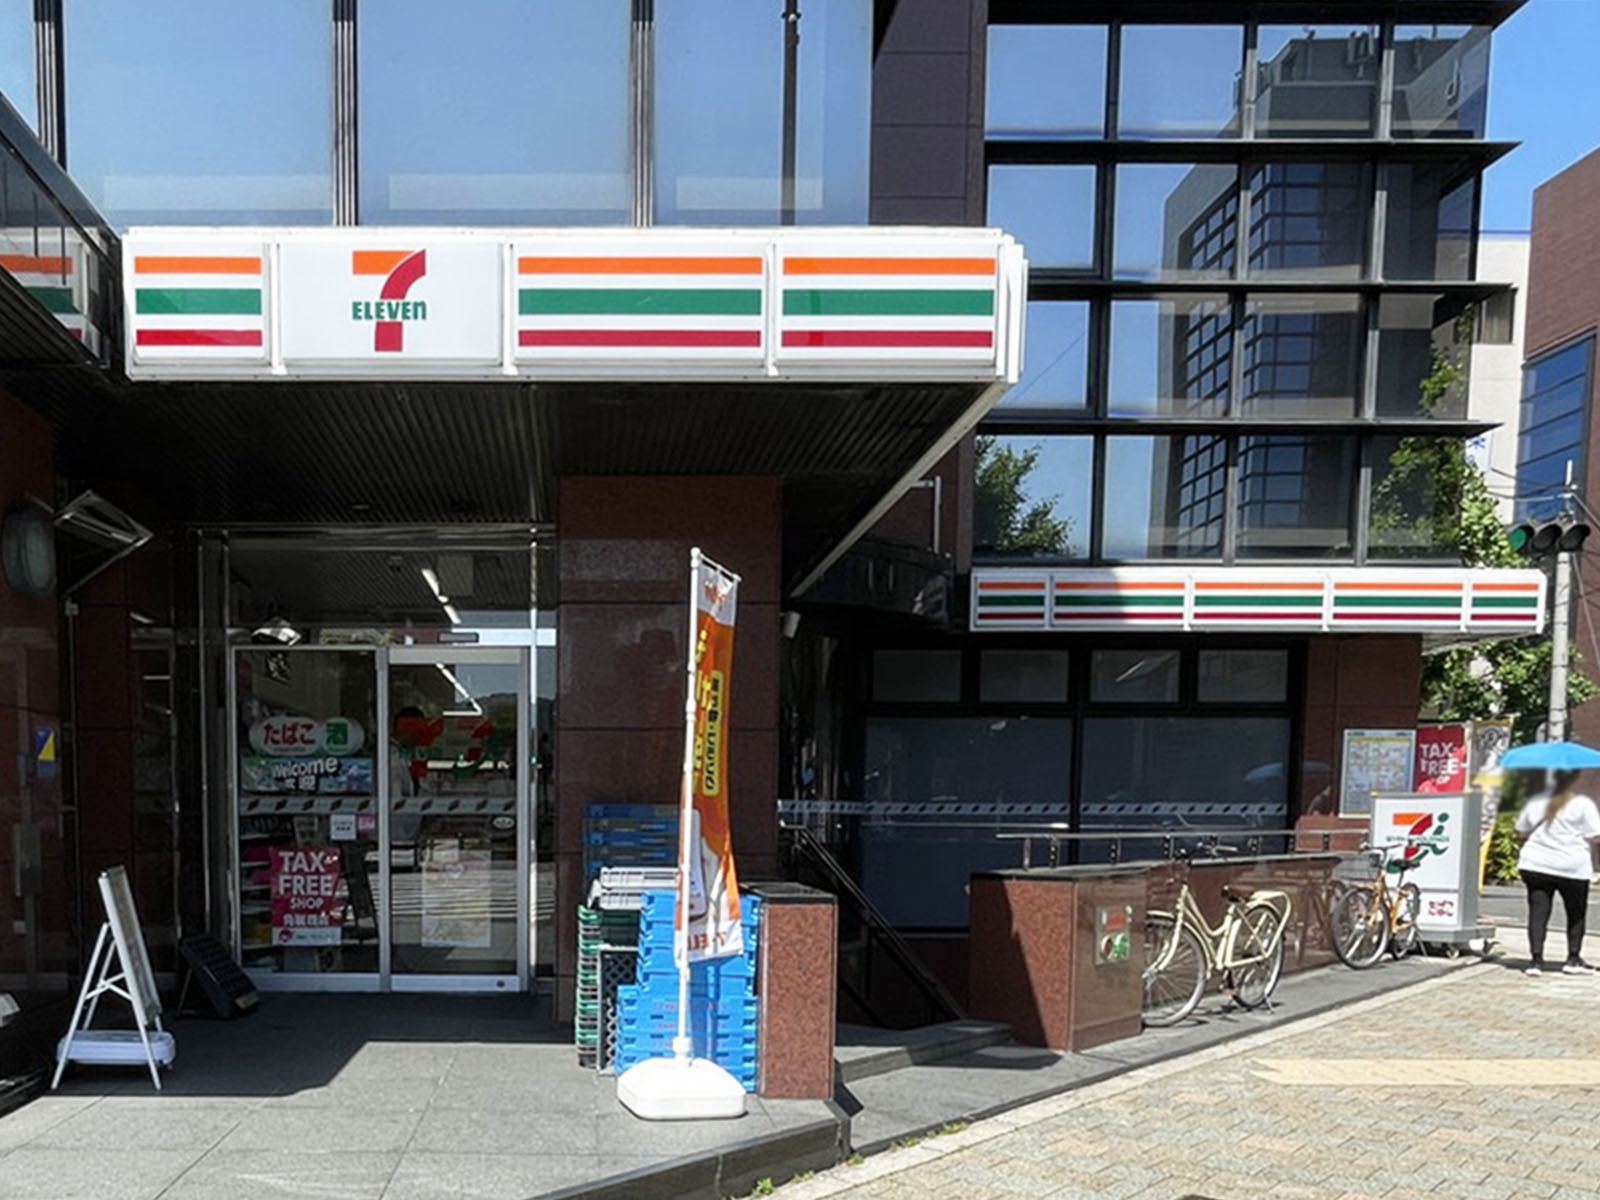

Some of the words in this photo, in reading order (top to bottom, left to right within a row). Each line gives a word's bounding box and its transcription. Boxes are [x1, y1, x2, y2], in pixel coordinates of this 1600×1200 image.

[352, 248, 427, 352] 7
[263, 723, 316, 745] たばこ
[1420, 742, 1454, 759] TAX
[278, 851, 326, 872] TAX
[278, 874, 333, 896] FREE
[290, 897, 324, 909] SHOP
